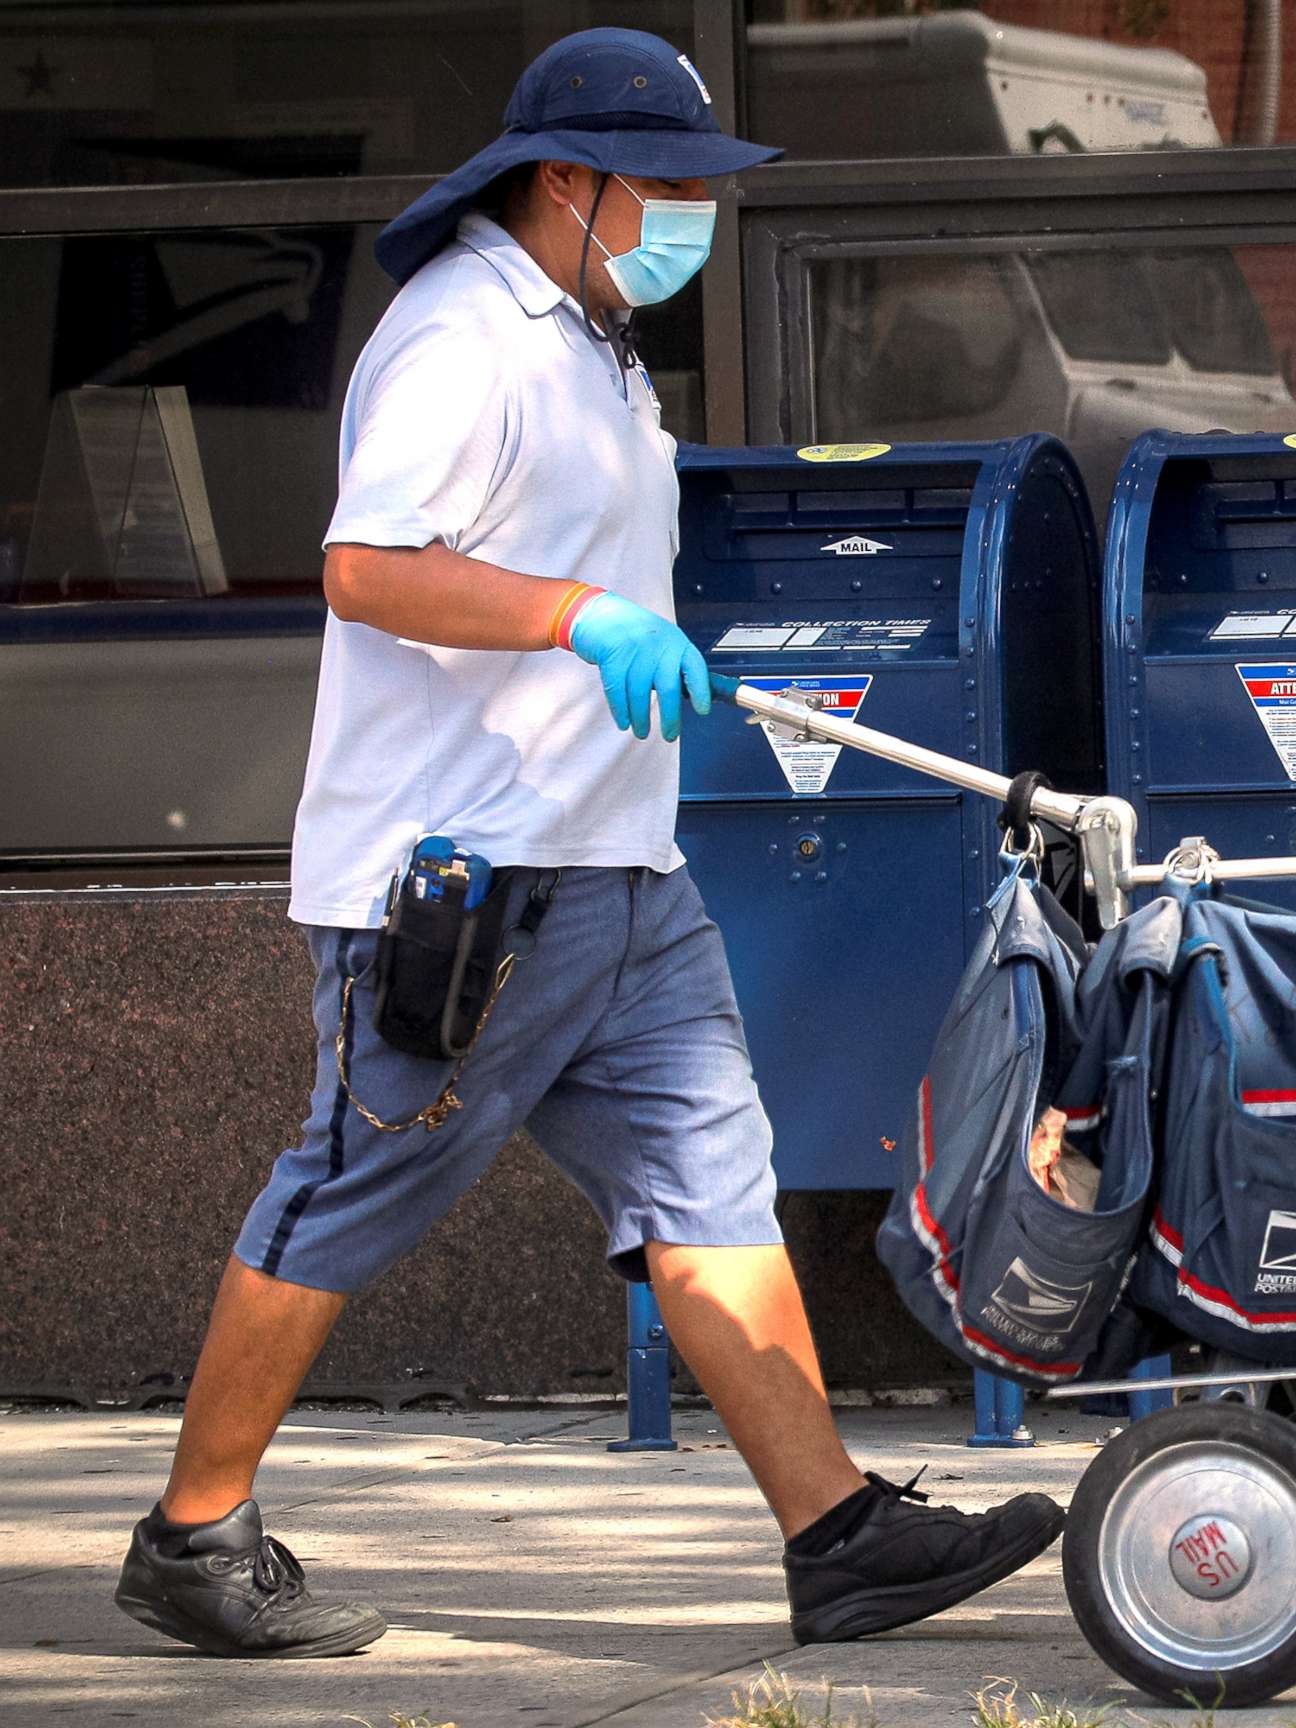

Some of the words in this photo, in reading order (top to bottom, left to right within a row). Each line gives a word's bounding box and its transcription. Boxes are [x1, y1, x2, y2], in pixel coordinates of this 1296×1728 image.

[840, 542, 873, 553] MAIL
[1175, 1521, 1227, 1564] MAIL
[1197, 1551, 1240, 1586] US
